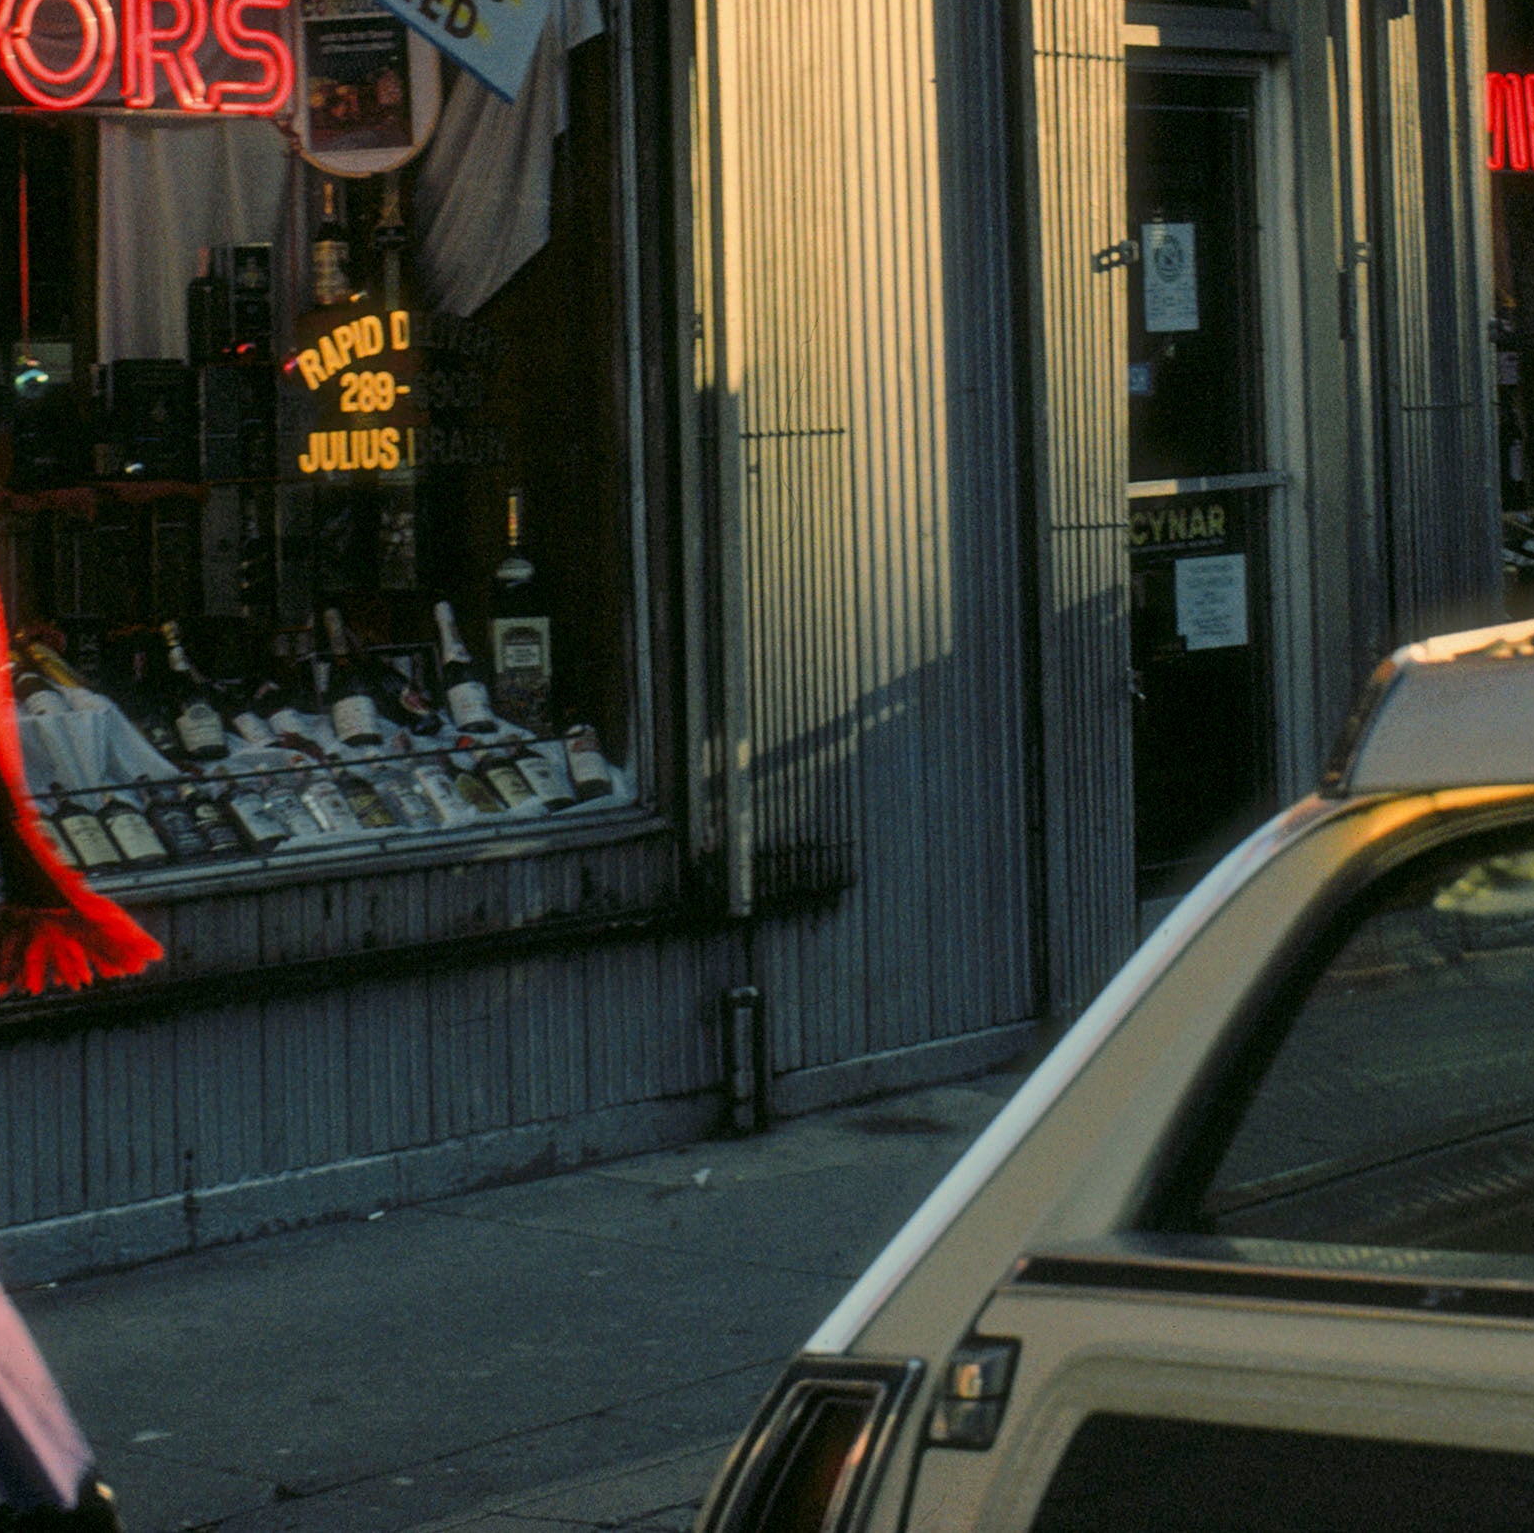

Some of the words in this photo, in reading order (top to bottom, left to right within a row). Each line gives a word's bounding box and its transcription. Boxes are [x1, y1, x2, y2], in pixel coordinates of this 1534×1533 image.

[296, 314, 385, 392] RAPID
[296, 426, 401, 475] JULIUS
[1128, 504, 1227, 546] CYNAR
